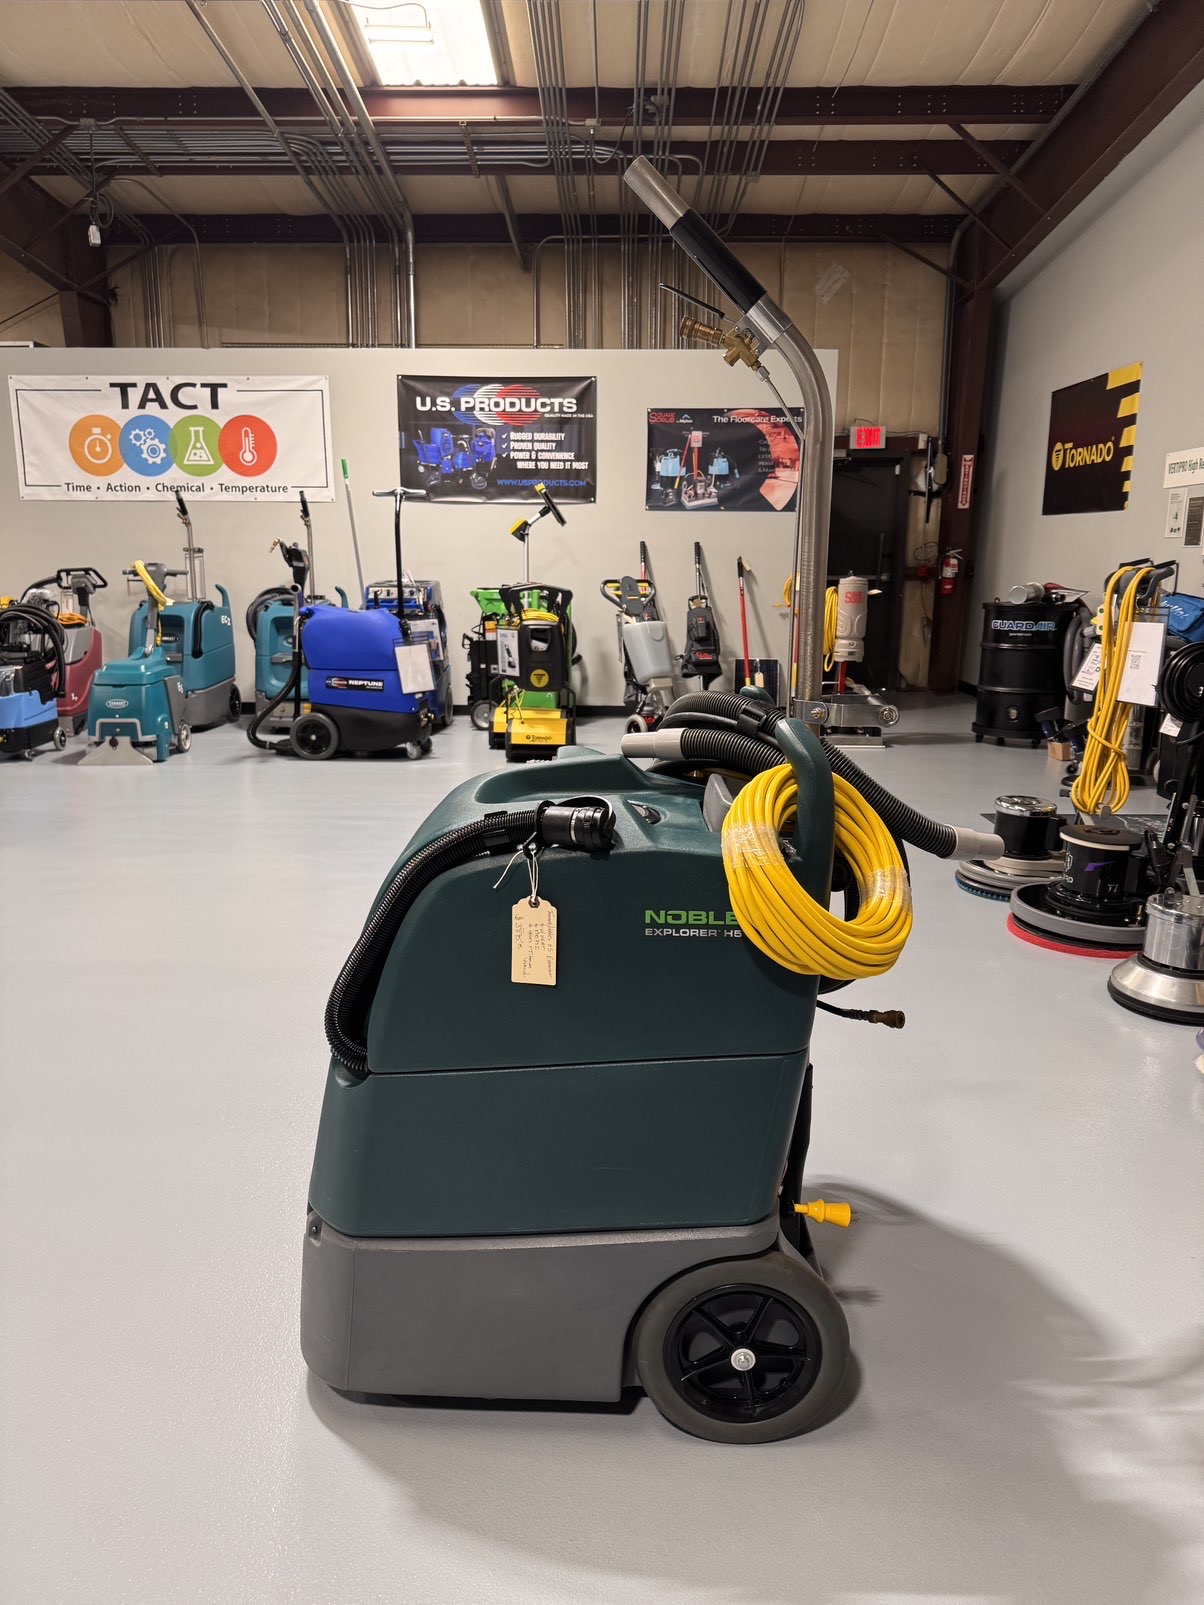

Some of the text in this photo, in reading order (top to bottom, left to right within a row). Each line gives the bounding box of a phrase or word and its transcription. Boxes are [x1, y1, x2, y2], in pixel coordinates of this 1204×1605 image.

[109, 382, 228, 410] TACT
[415, 396, 577, 413] U.S. PRODUCTS
[510, 432, 566, 441] RUGGED DURABILITY
[856, 427, 881, 448] EXIT
[510, 442, 556, 450] PROVEN QUALITY
[510, 452, 530, 460] POWER
[537, 452, 575, 460] CONVENIENCE
[1064, 441, 1114, 468] TORNADO
[516, 461, 589, 470] WHERE YOU NEED IT MOST
[65, 482, 289, 494] Time Action Chemical Temperature
[992, 620, 1056, 631] GUARDAIR
[645, 928, 742, 938] EXPLORER H5
